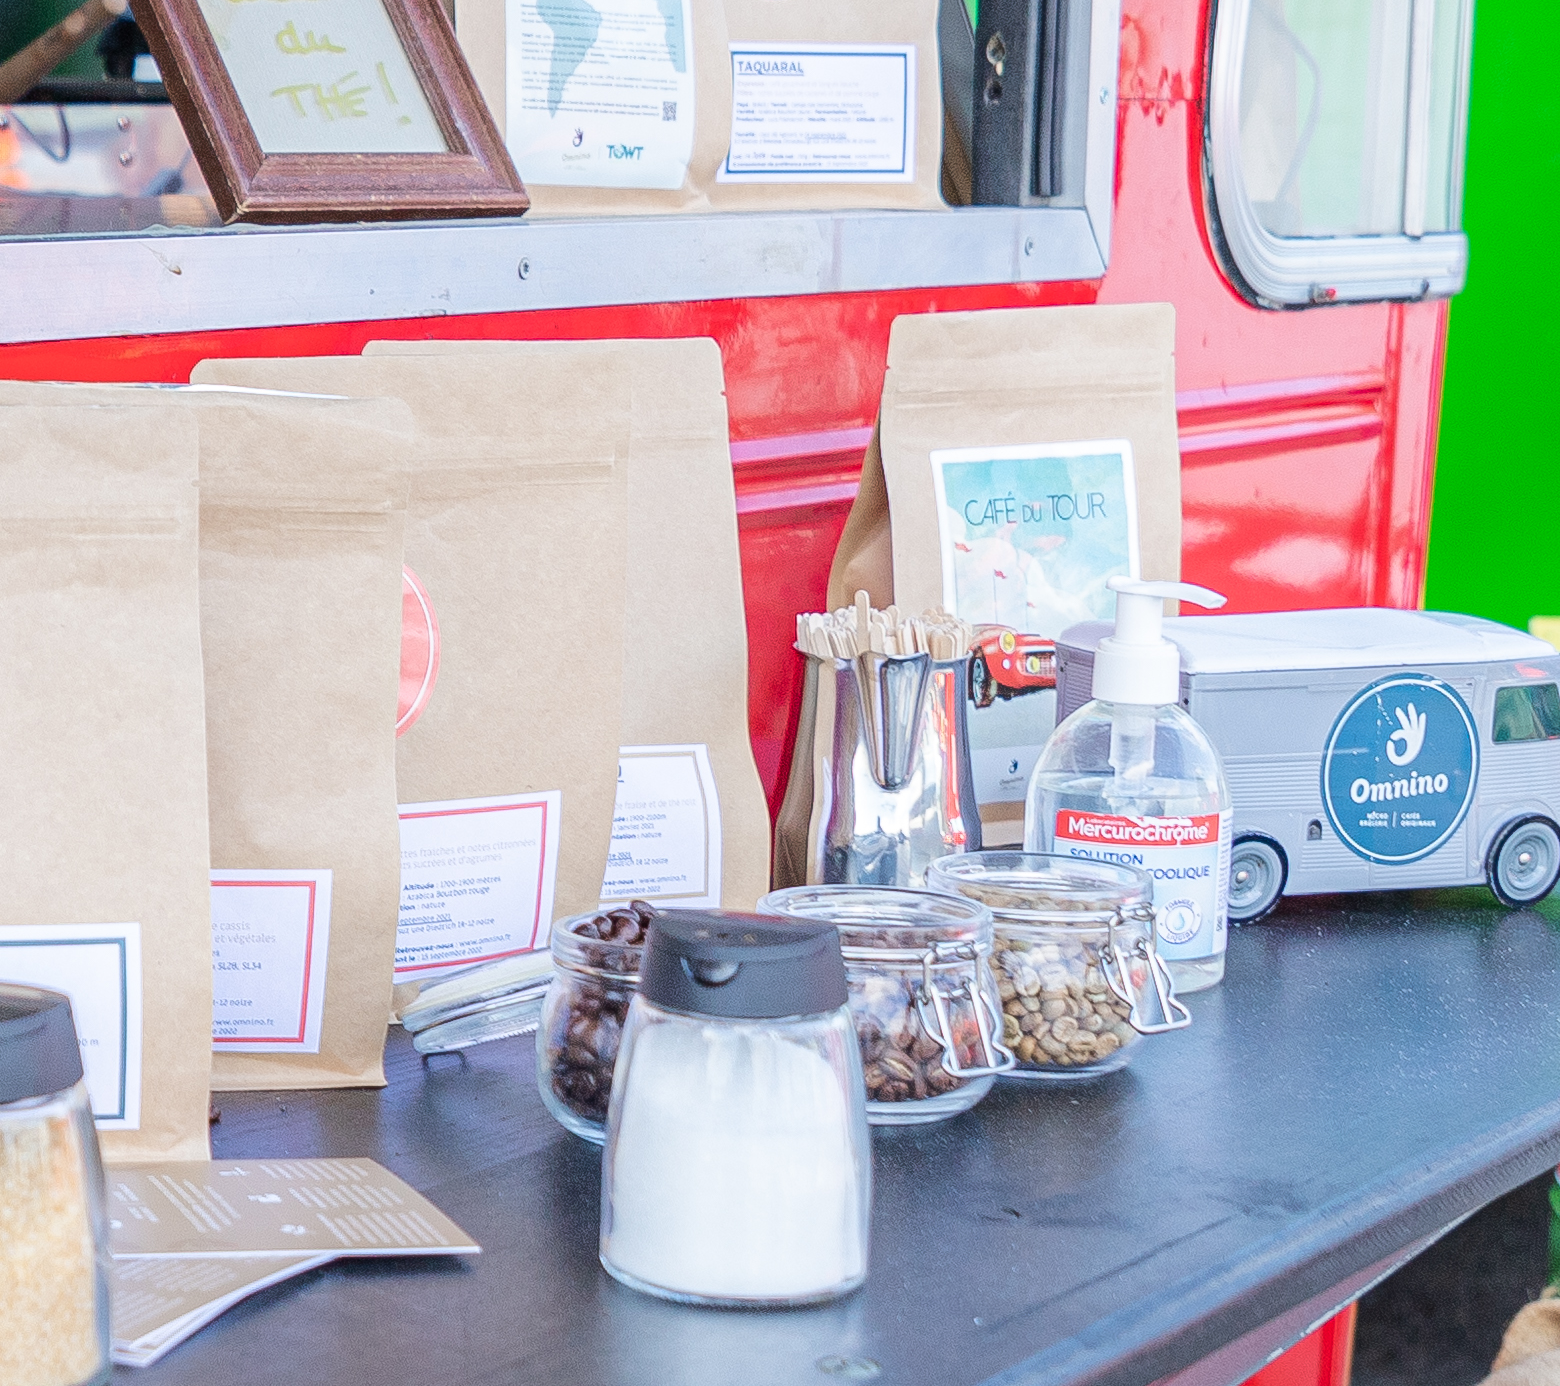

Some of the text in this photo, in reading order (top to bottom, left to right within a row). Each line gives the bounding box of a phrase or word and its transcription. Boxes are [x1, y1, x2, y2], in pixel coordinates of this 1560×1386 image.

[276, 20, 346, 54] du
[737, 60, 804, 75] TAQUARAL
[606, 144, 644, 160] TOWT
[965, 491, 1107, 526] CAFÉ DU TOUR
[1350, 770, 1449, 804] Omnino
[1068, 816, 1209, 842] Mercurochrome
[1146, 865, 1211, 880] COOLIQUE
[220, 921, 251, 932] cassis
[399, 914, 435, 925] eptembre
